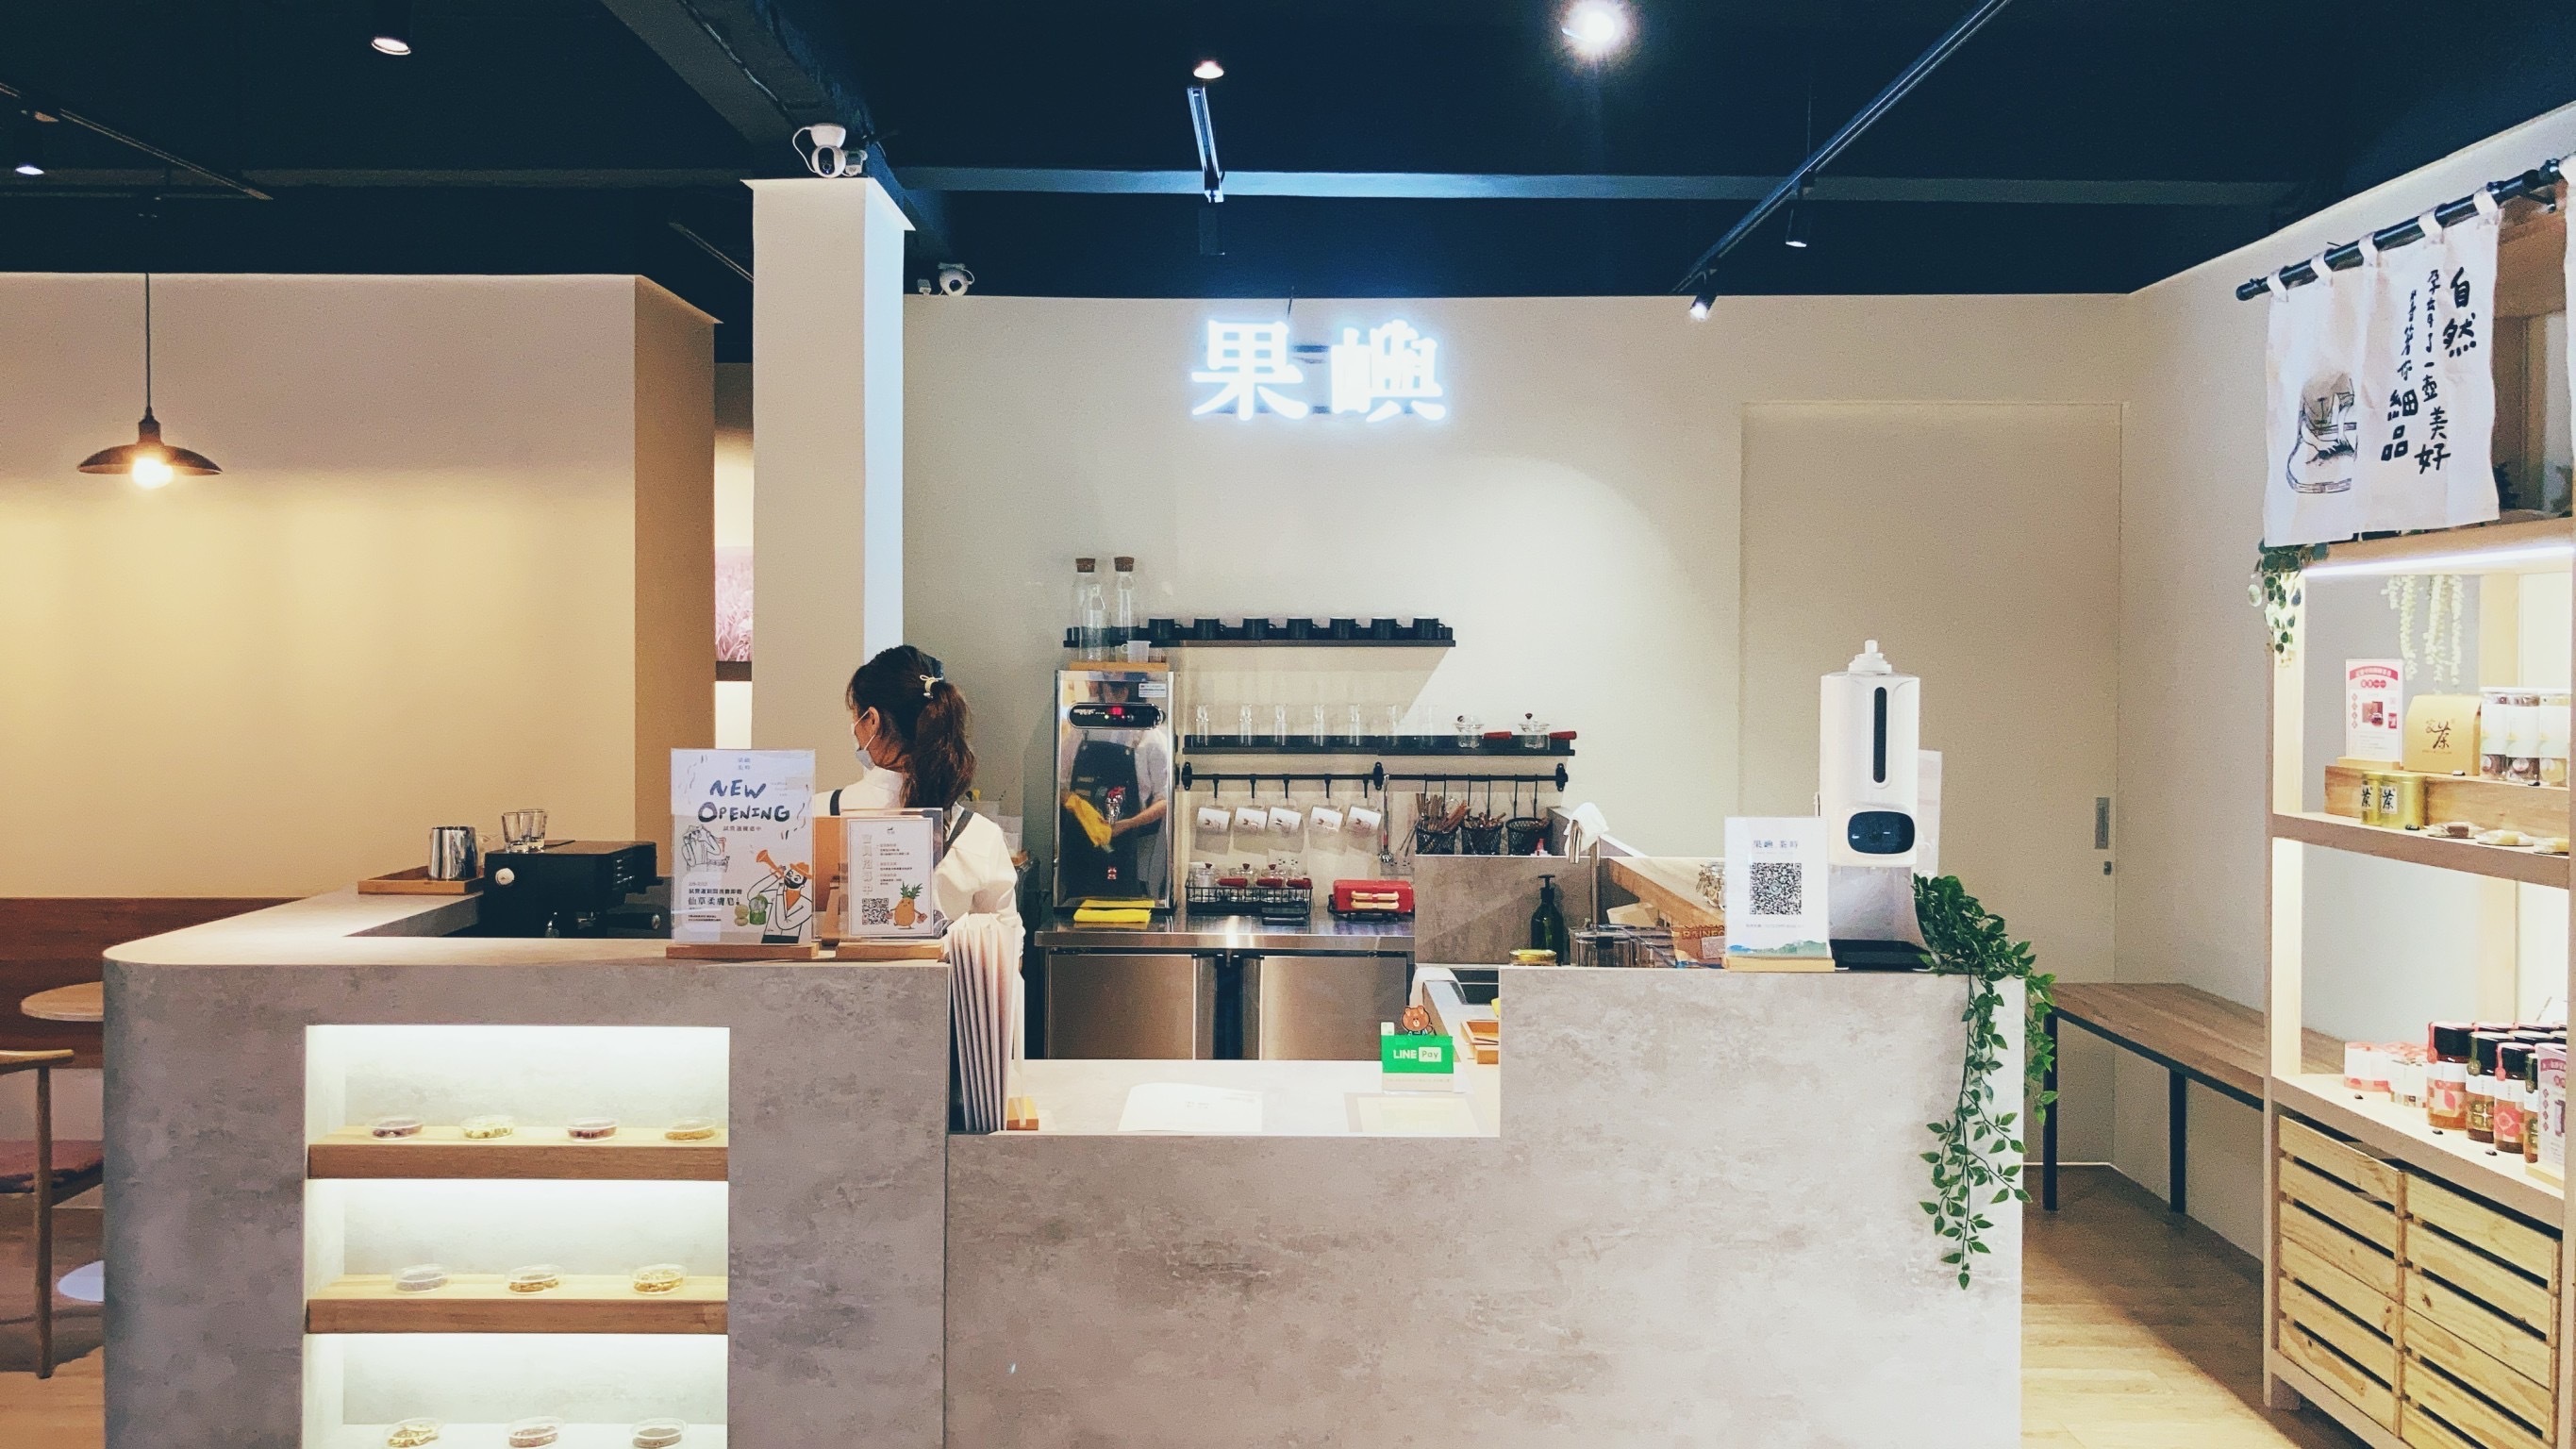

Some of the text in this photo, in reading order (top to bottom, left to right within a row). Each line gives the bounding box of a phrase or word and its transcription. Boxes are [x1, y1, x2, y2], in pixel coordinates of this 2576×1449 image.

[2442, 266, 2477, 358] 自然
[1191, 319, 1446, 423] 果嶼
[709, 778, 766, 799] NEW
[2383, 789, 2395, 810] 茶
[698, 802, 790, 823] OPENING
[1393, 1049, 1439, 1060] LINE Pay
